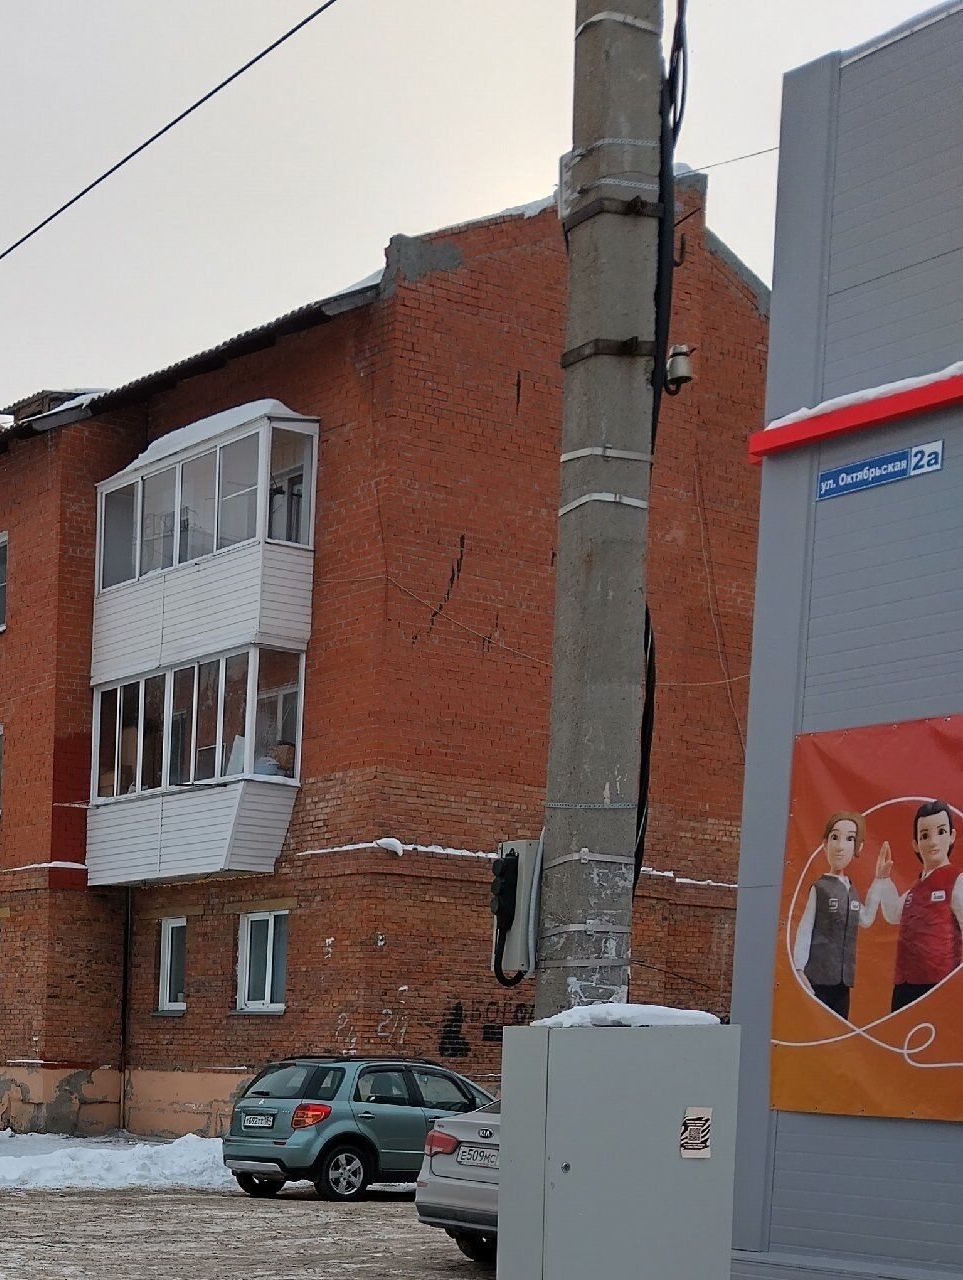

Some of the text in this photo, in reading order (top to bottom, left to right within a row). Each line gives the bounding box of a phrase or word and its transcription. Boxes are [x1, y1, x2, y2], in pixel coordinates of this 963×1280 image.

[820, 449, 940, 494] ул. Октябрьская 2а
